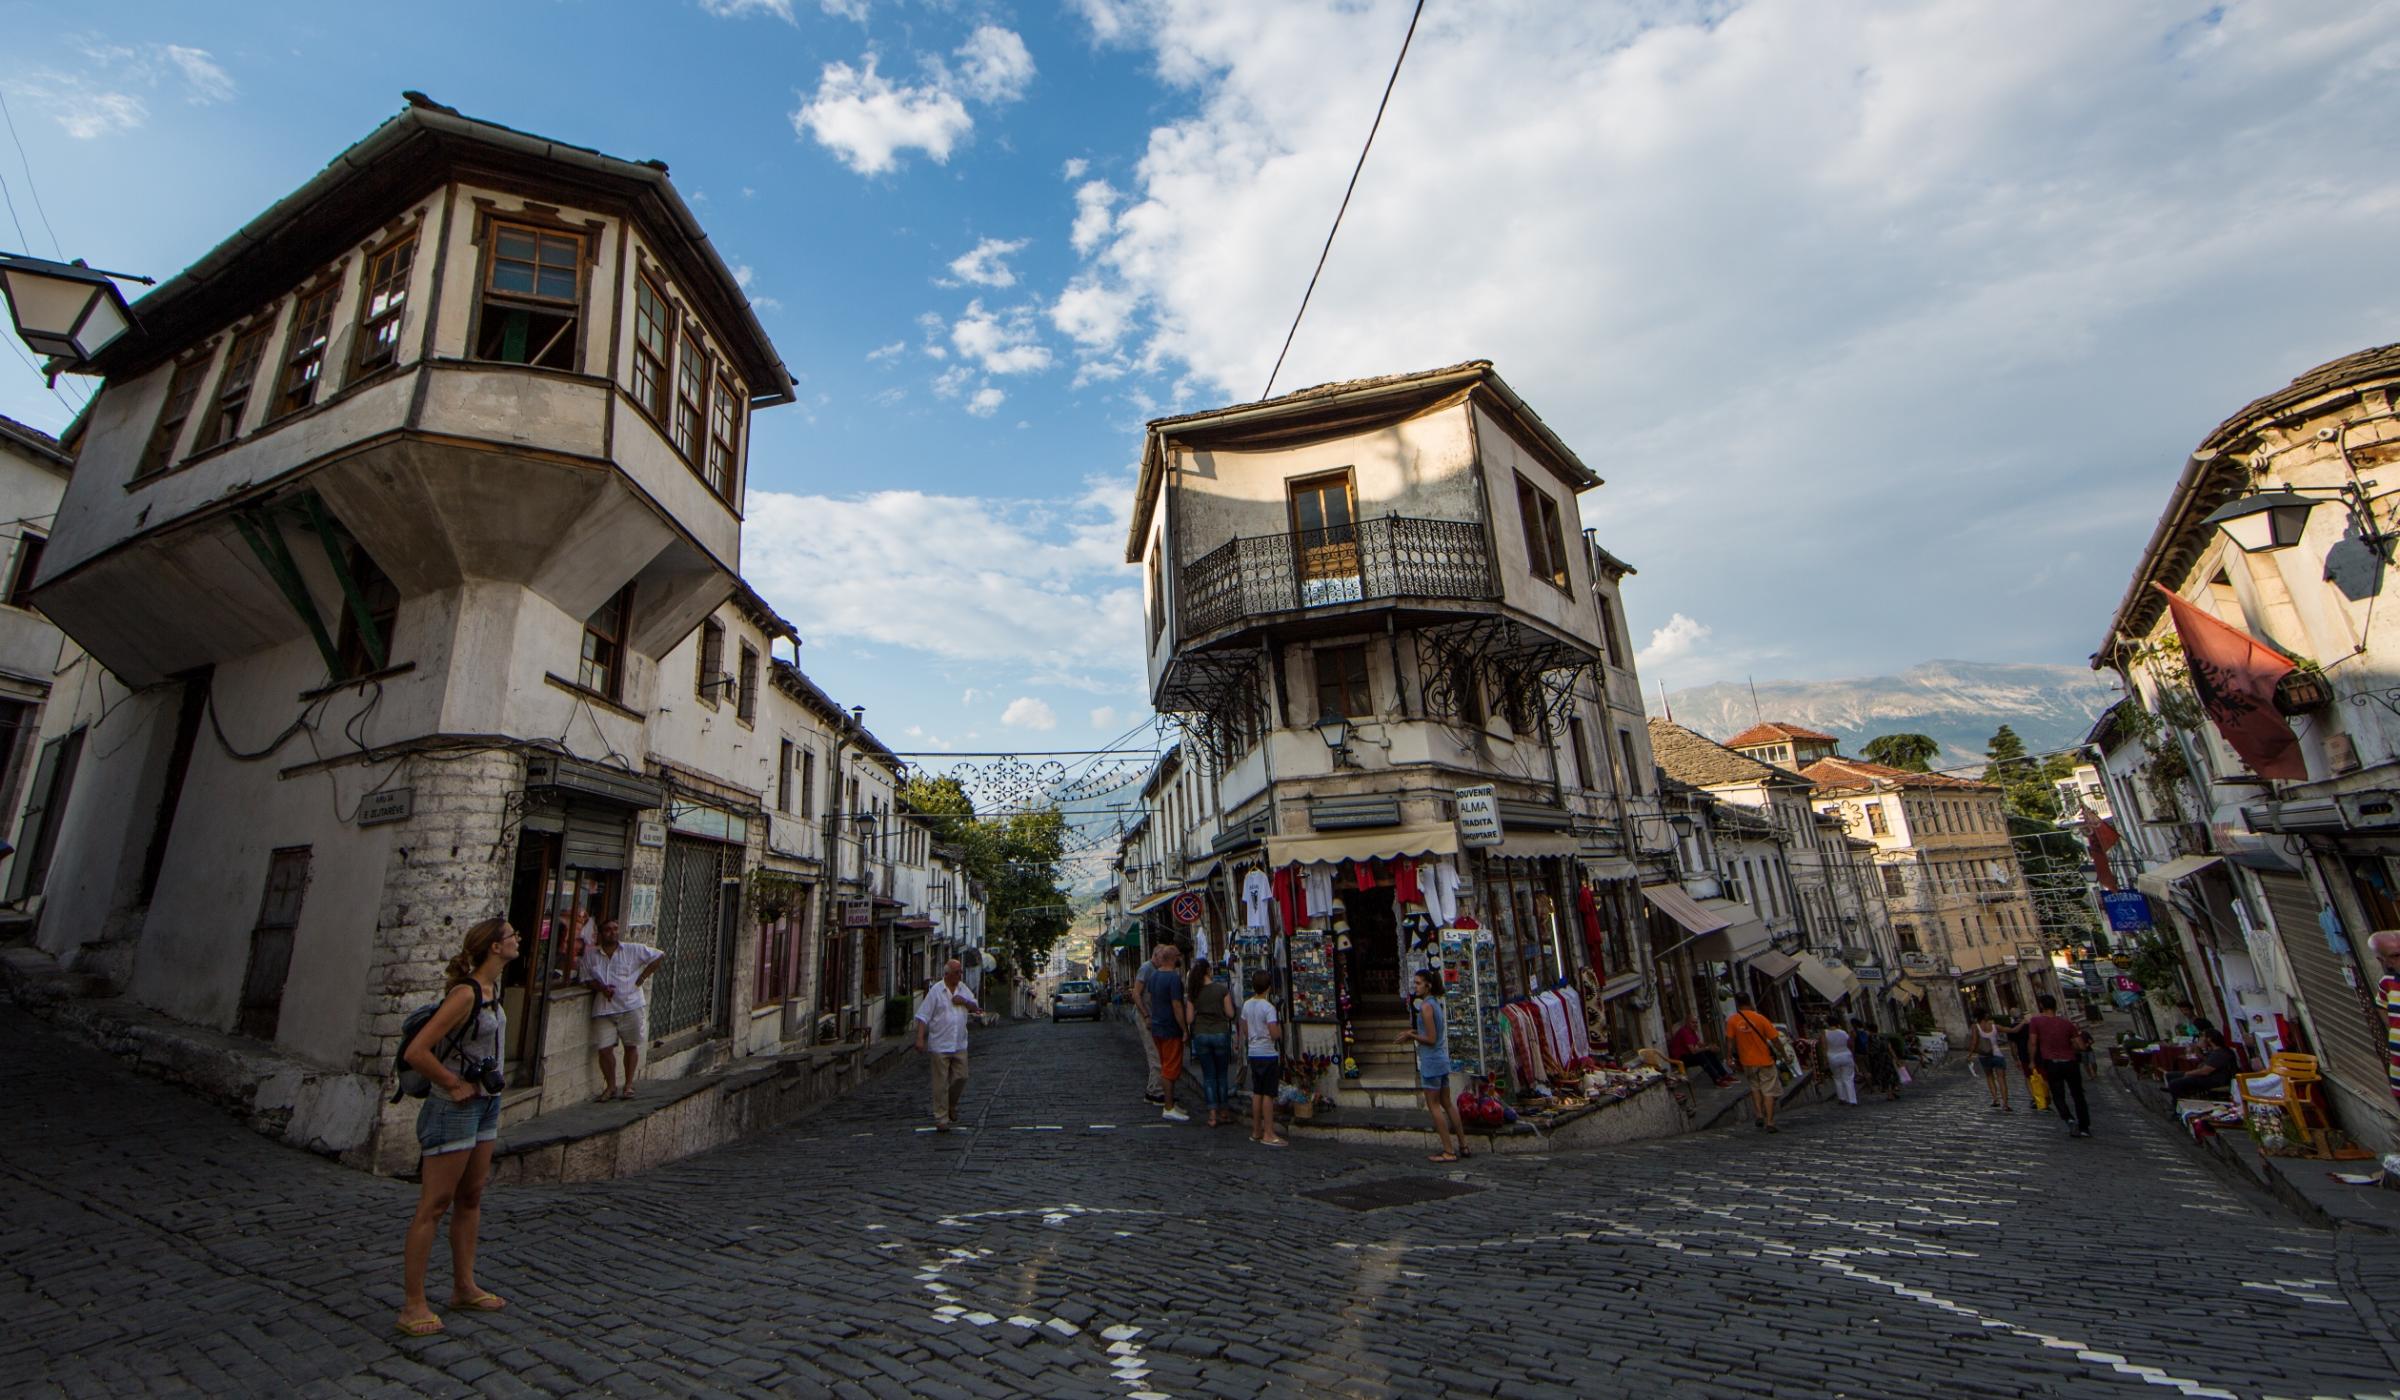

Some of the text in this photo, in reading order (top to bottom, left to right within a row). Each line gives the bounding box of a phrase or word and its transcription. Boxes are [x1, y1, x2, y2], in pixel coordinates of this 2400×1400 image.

[1456, 788, 1492, 799] SOUVENIR
[1461, 802, 1488, 813] ALMA
[1462, 818, 1493, 827] TRADITA
[848, 915, 869, 924] FLORA
